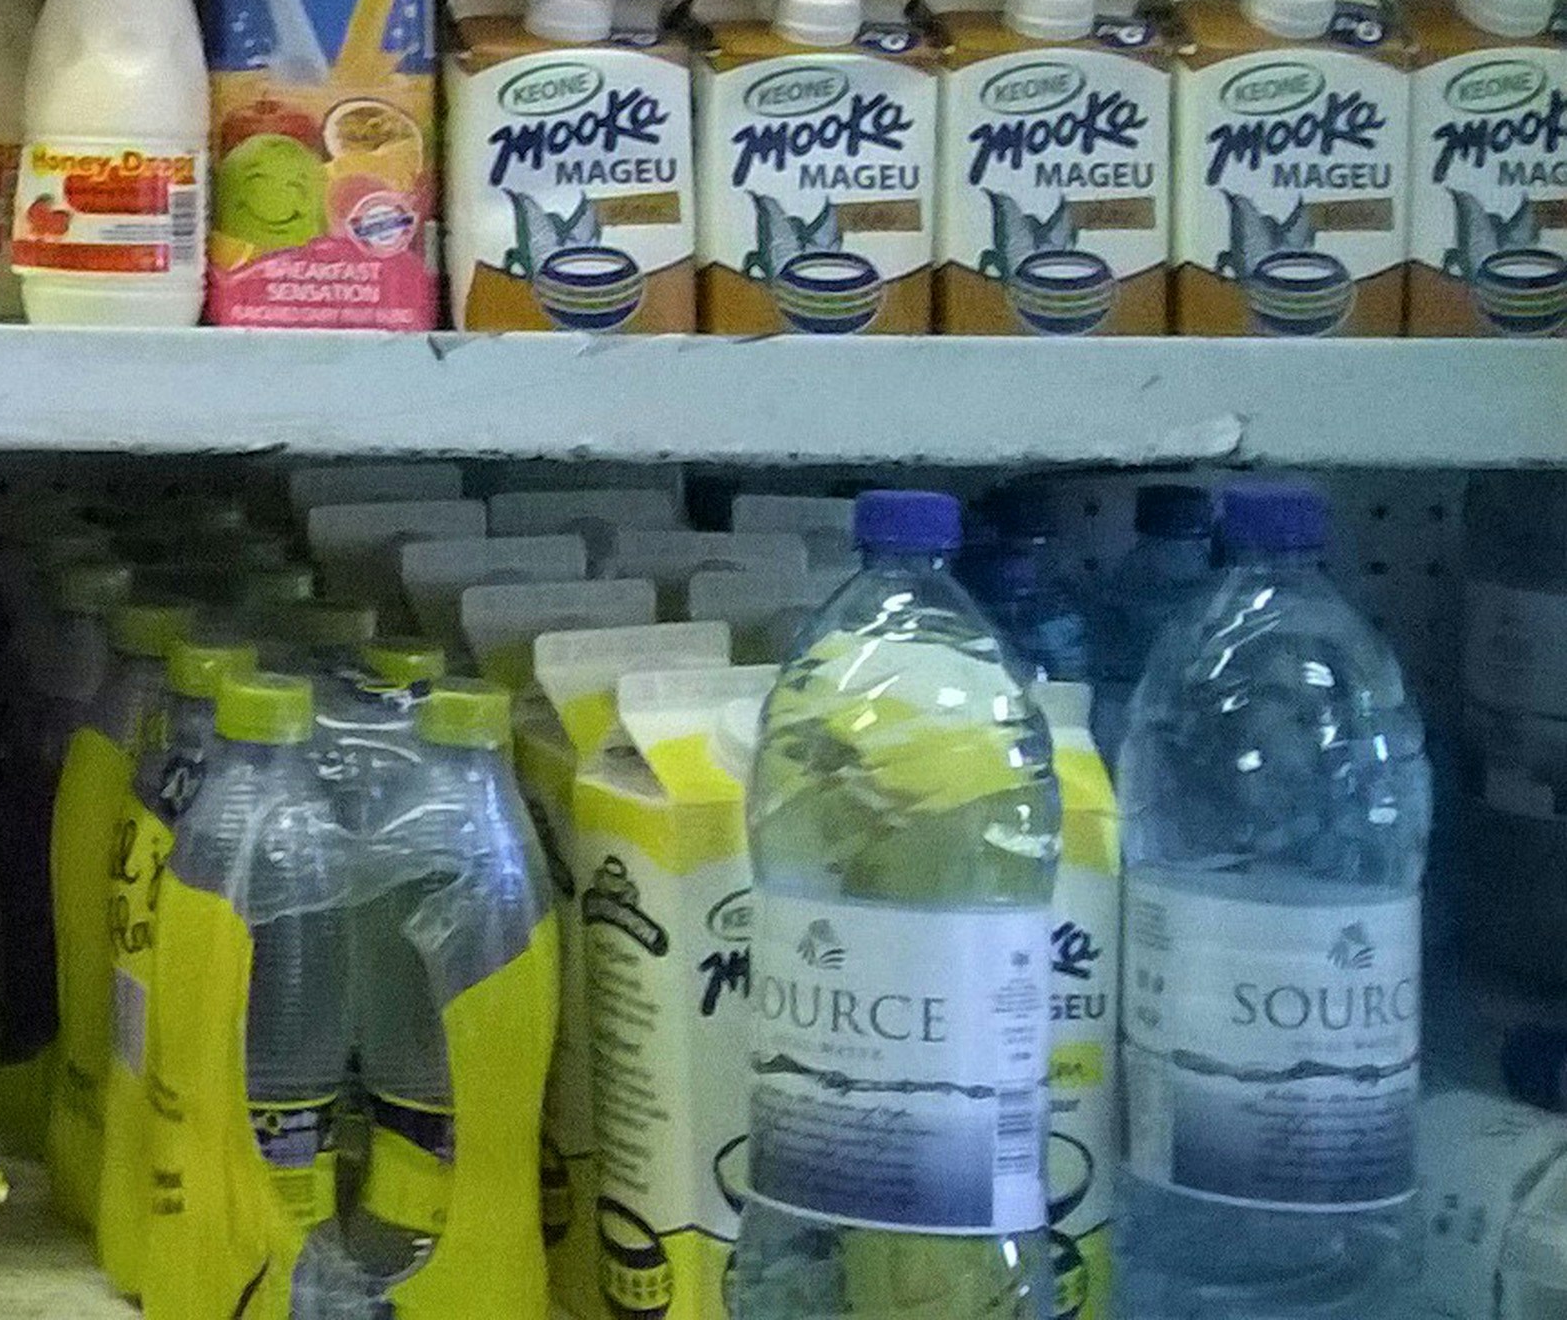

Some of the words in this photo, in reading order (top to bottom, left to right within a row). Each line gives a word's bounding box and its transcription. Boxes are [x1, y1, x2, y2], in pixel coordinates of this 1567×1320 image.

[556, 157, 677, 185] MAGEU
[799, 163, 921, 191] MAGEU
[1034, 161, 1155, 189] MAGEU
[1272, 161, 1393, 190] MAGEU
[1496, 160, 1567, 187] MAG
[759, 975, 947, 1043] OURCE
[1232, 980, 1418, 1031] SOURC
